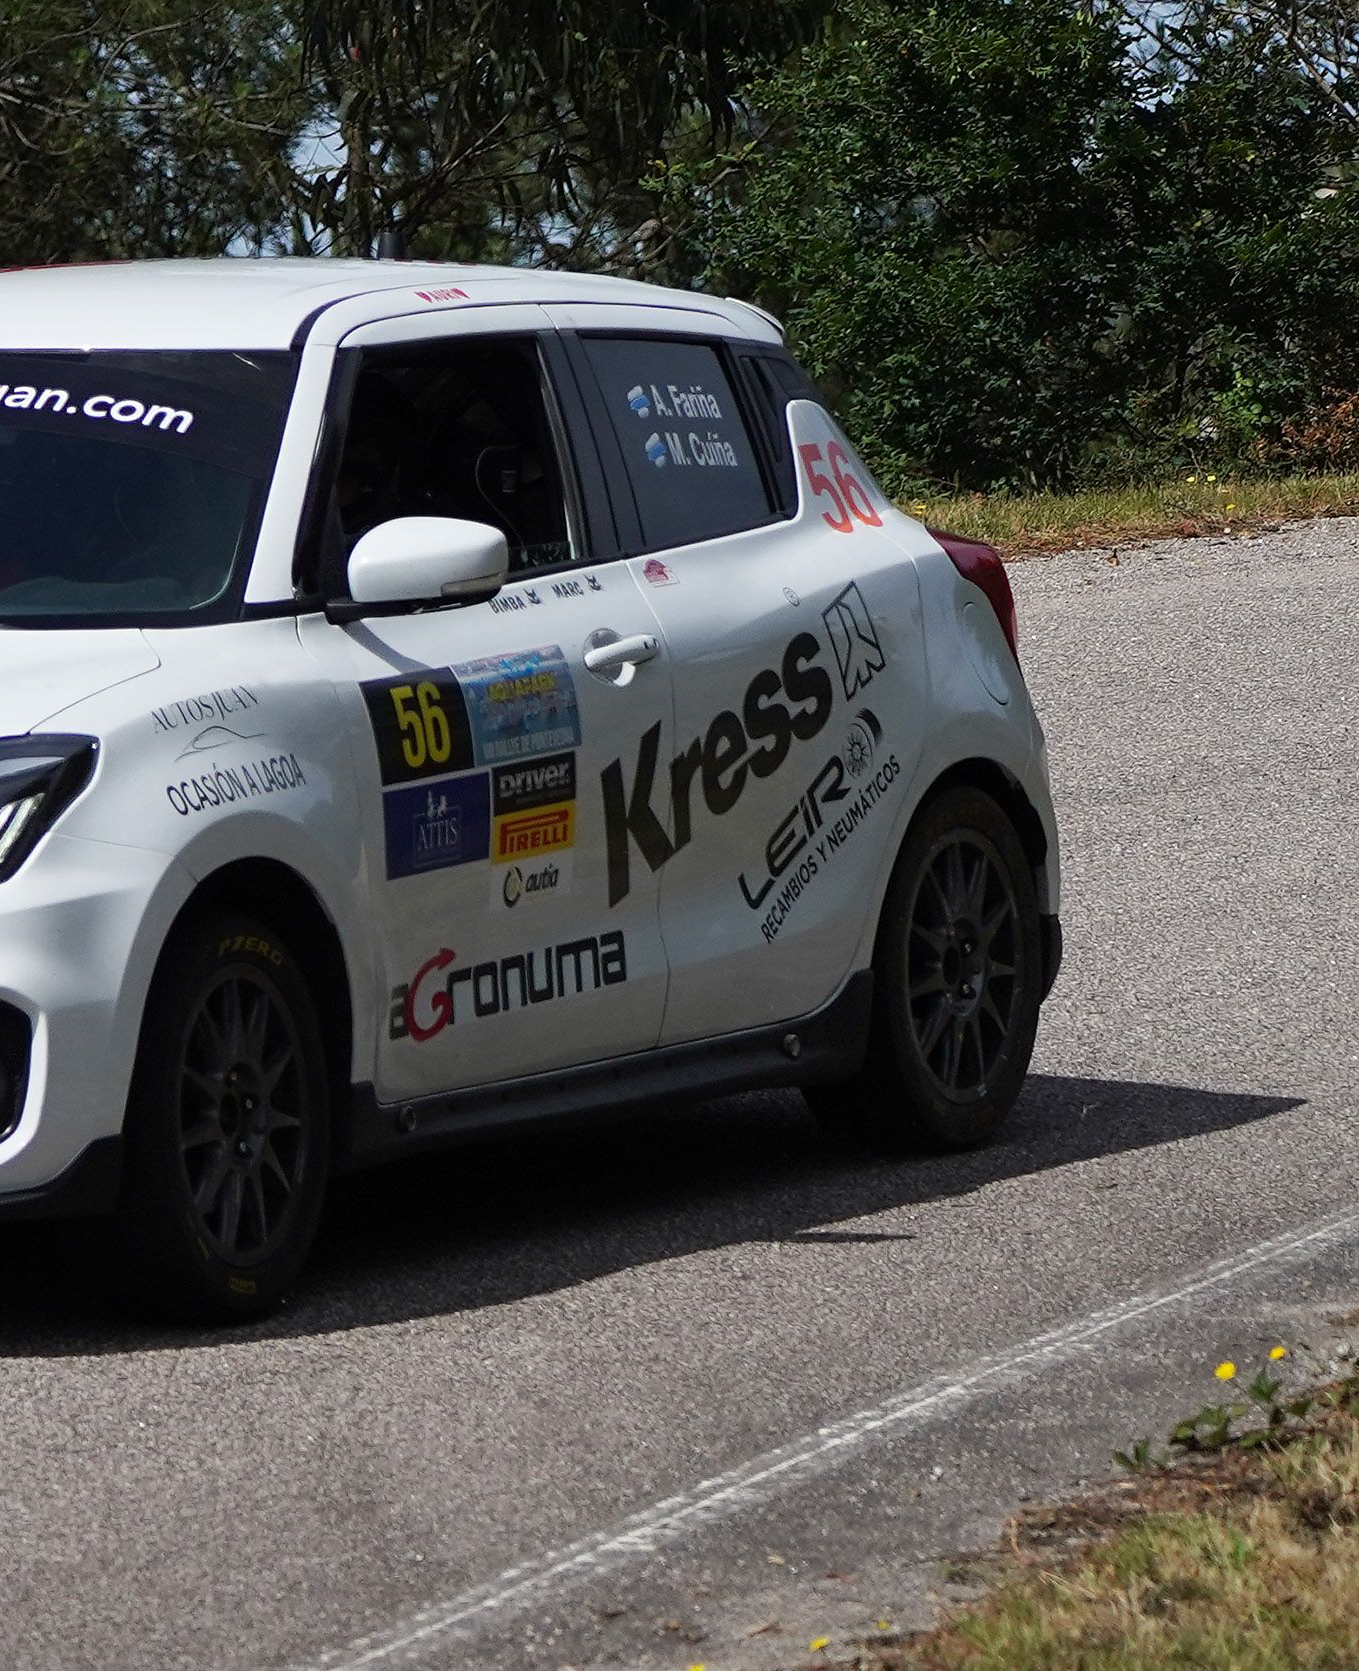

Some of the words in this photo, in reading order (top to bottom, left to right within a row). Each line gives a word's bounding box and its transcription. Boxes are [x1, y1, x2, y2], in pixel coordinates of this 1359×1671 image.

[649, 384, 673, 417] A.
[666, 384, 723, 419] Fariña
[664, 431, 691, 466] M.
[798, 440, 883, 534] 56
[488, 596, 527, 614] BIMBA
[551, 581, 584, 598] MARC
[389, 680, 452, 769] 56
[167, 763, 248, 816] OCASIÓN
[241, 765, 261, 795] A
[252, 753, 307, 793] LAGOA
[599, 631, 833, 908] Kress
[417, 816, 459, 852] ATTIS
[498, 808, 570, 856] PIRELLI
[738, 755, 851, 910] LEIR
[760, 854, 819, 944] RECAMBIOS
[815, 841, 828, 863] Y
[826, 754, 901, 854] NEUMÁTICOS
